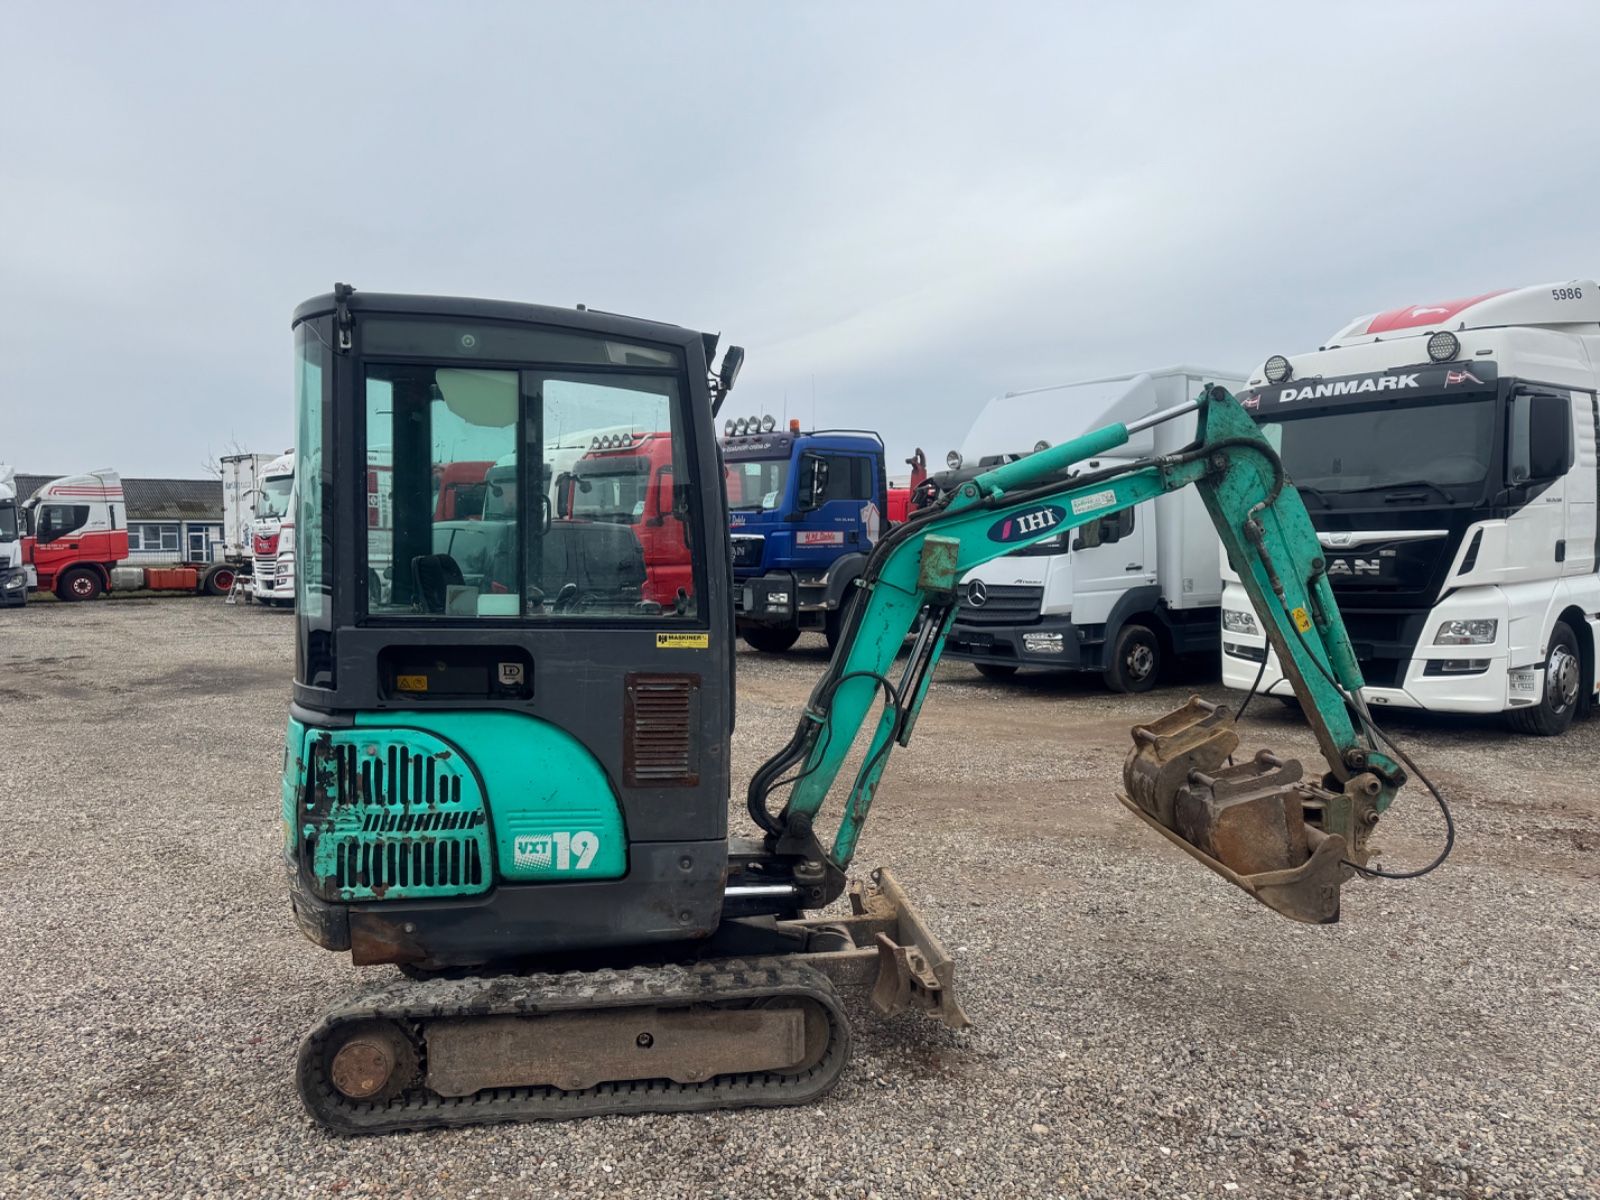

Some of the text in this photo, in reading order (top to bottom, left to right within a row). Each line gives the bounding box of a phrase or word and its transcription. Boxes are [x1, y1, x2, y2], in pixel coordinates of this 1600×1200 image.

[1552, 287, 1582, 300] 5986
[1279, 373, 1420, 403] DANMARK
[1016, 508, 1057, 534] IHI
[1327, 559, 1380, 575] AN
[518, 830, 599, 870] VXT 19
